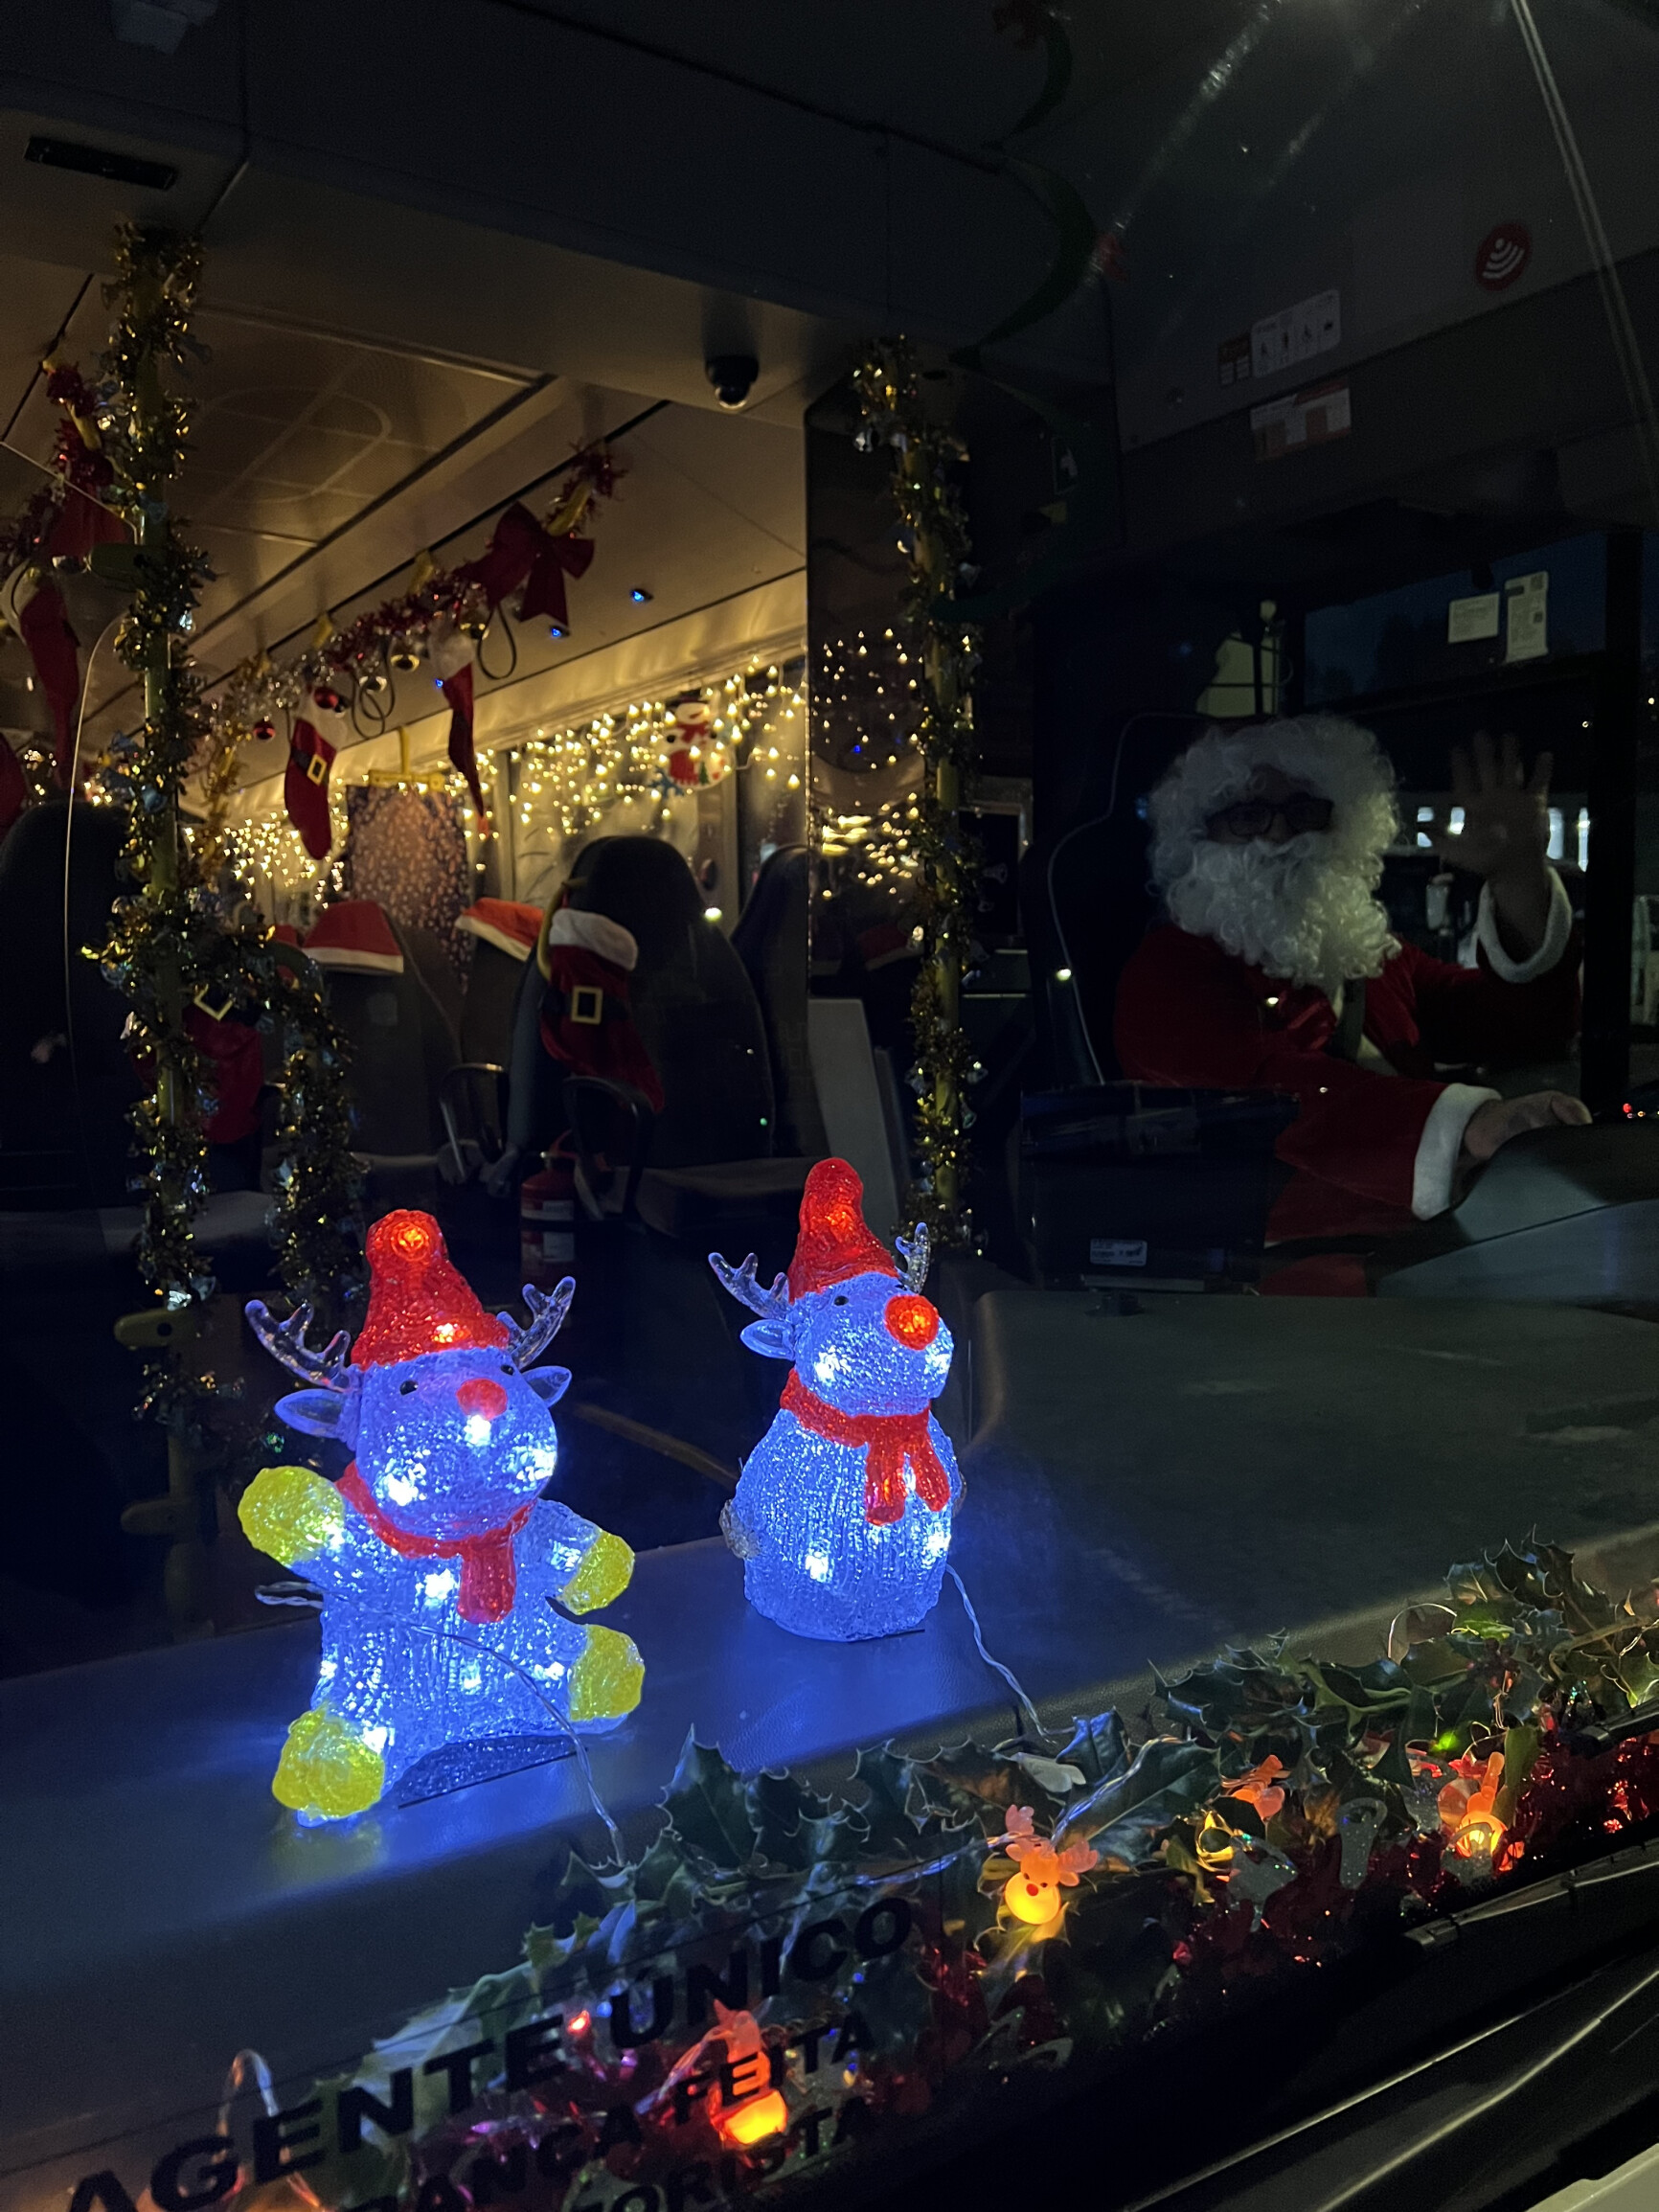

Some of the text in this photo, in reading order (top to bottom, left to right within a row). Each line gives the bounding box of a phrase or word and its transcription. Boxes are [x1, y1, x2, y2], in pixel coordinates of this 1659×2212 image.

[65, 1897, 911, 2212] AGENTE ÚNICO
[676, 2011, 875, 2124] FEITA
